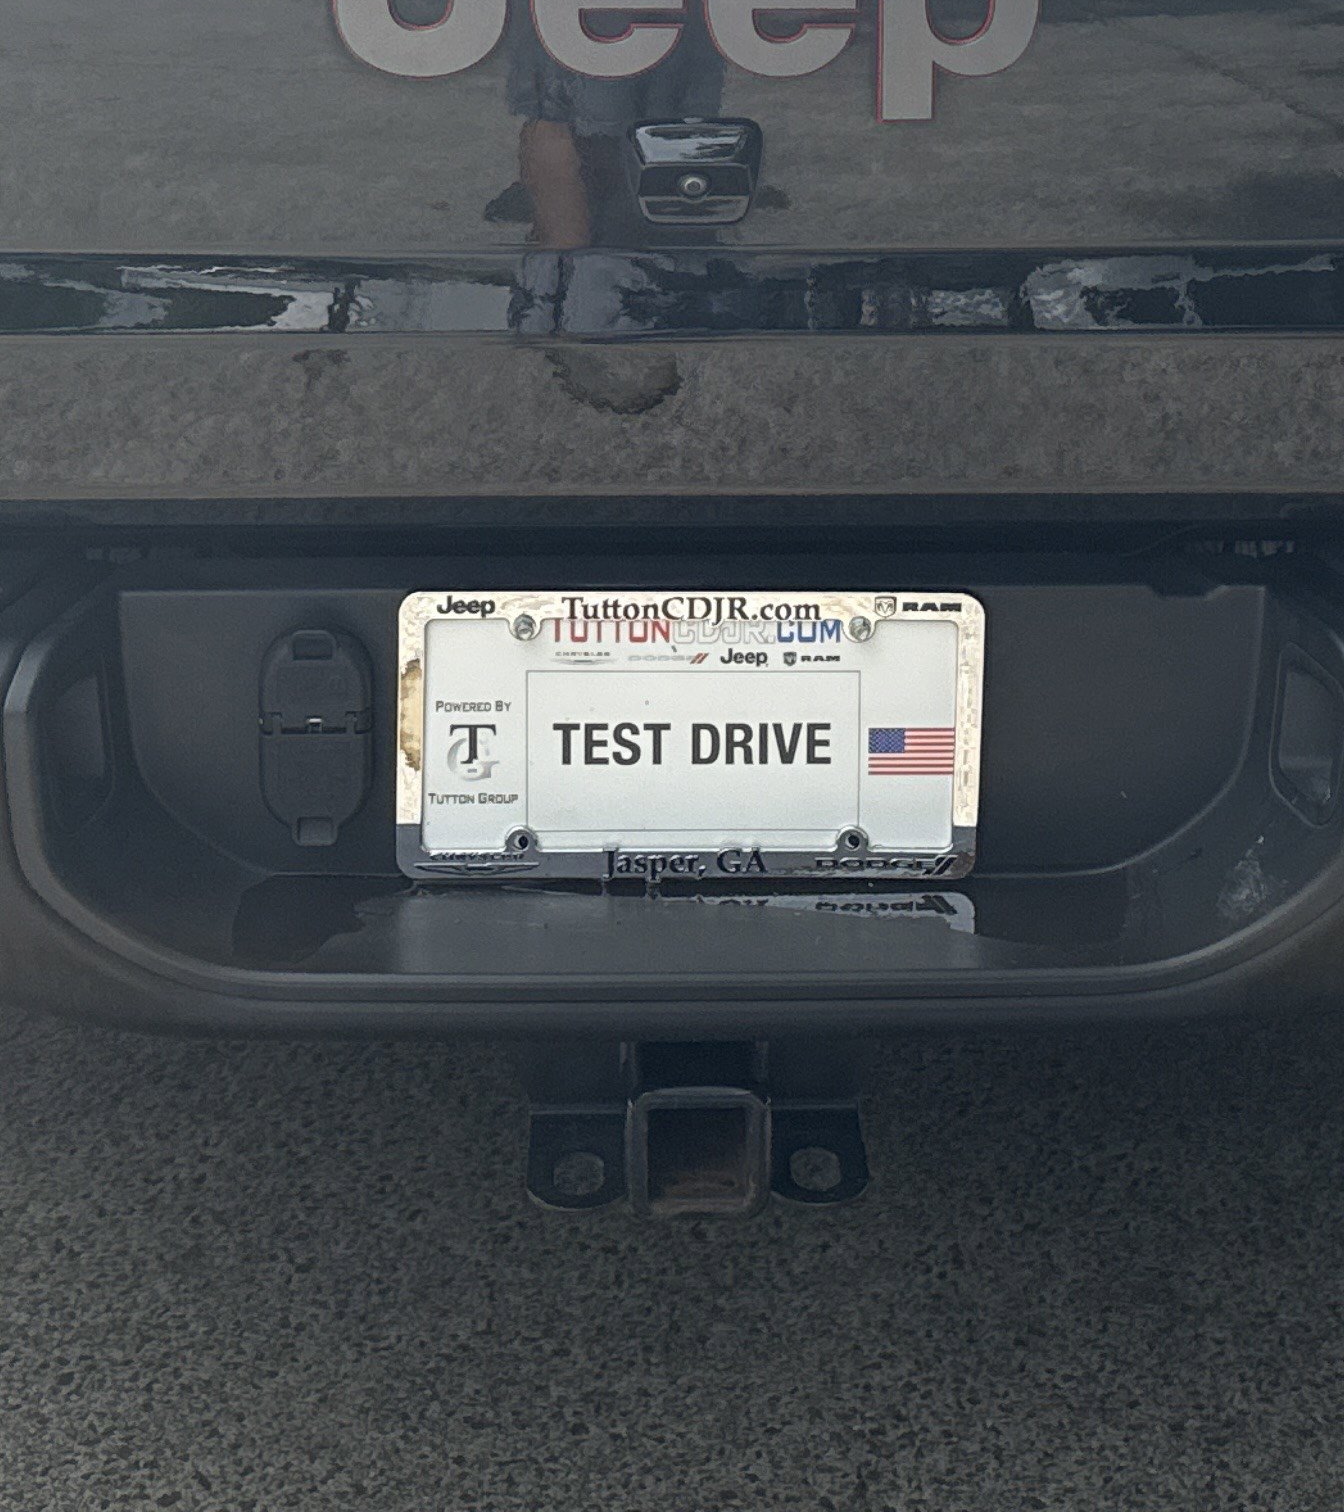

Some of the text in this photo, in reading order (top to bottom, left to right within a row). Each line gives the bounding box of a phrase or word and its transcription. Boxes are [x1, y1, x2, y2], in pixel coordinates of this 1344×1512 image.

[436, 595, 496, 618] Jeep
[561, 596, 822, 626] TuttonCDJR.com
[901, 601, 963, 613] RAM
[720, 648, 768, 667] Jeep
[800, 654, 841, 662] RAM
[552, 722, 832, 766] TEST DRIVE
[601, 847, 768, 881] Jasper, GA
